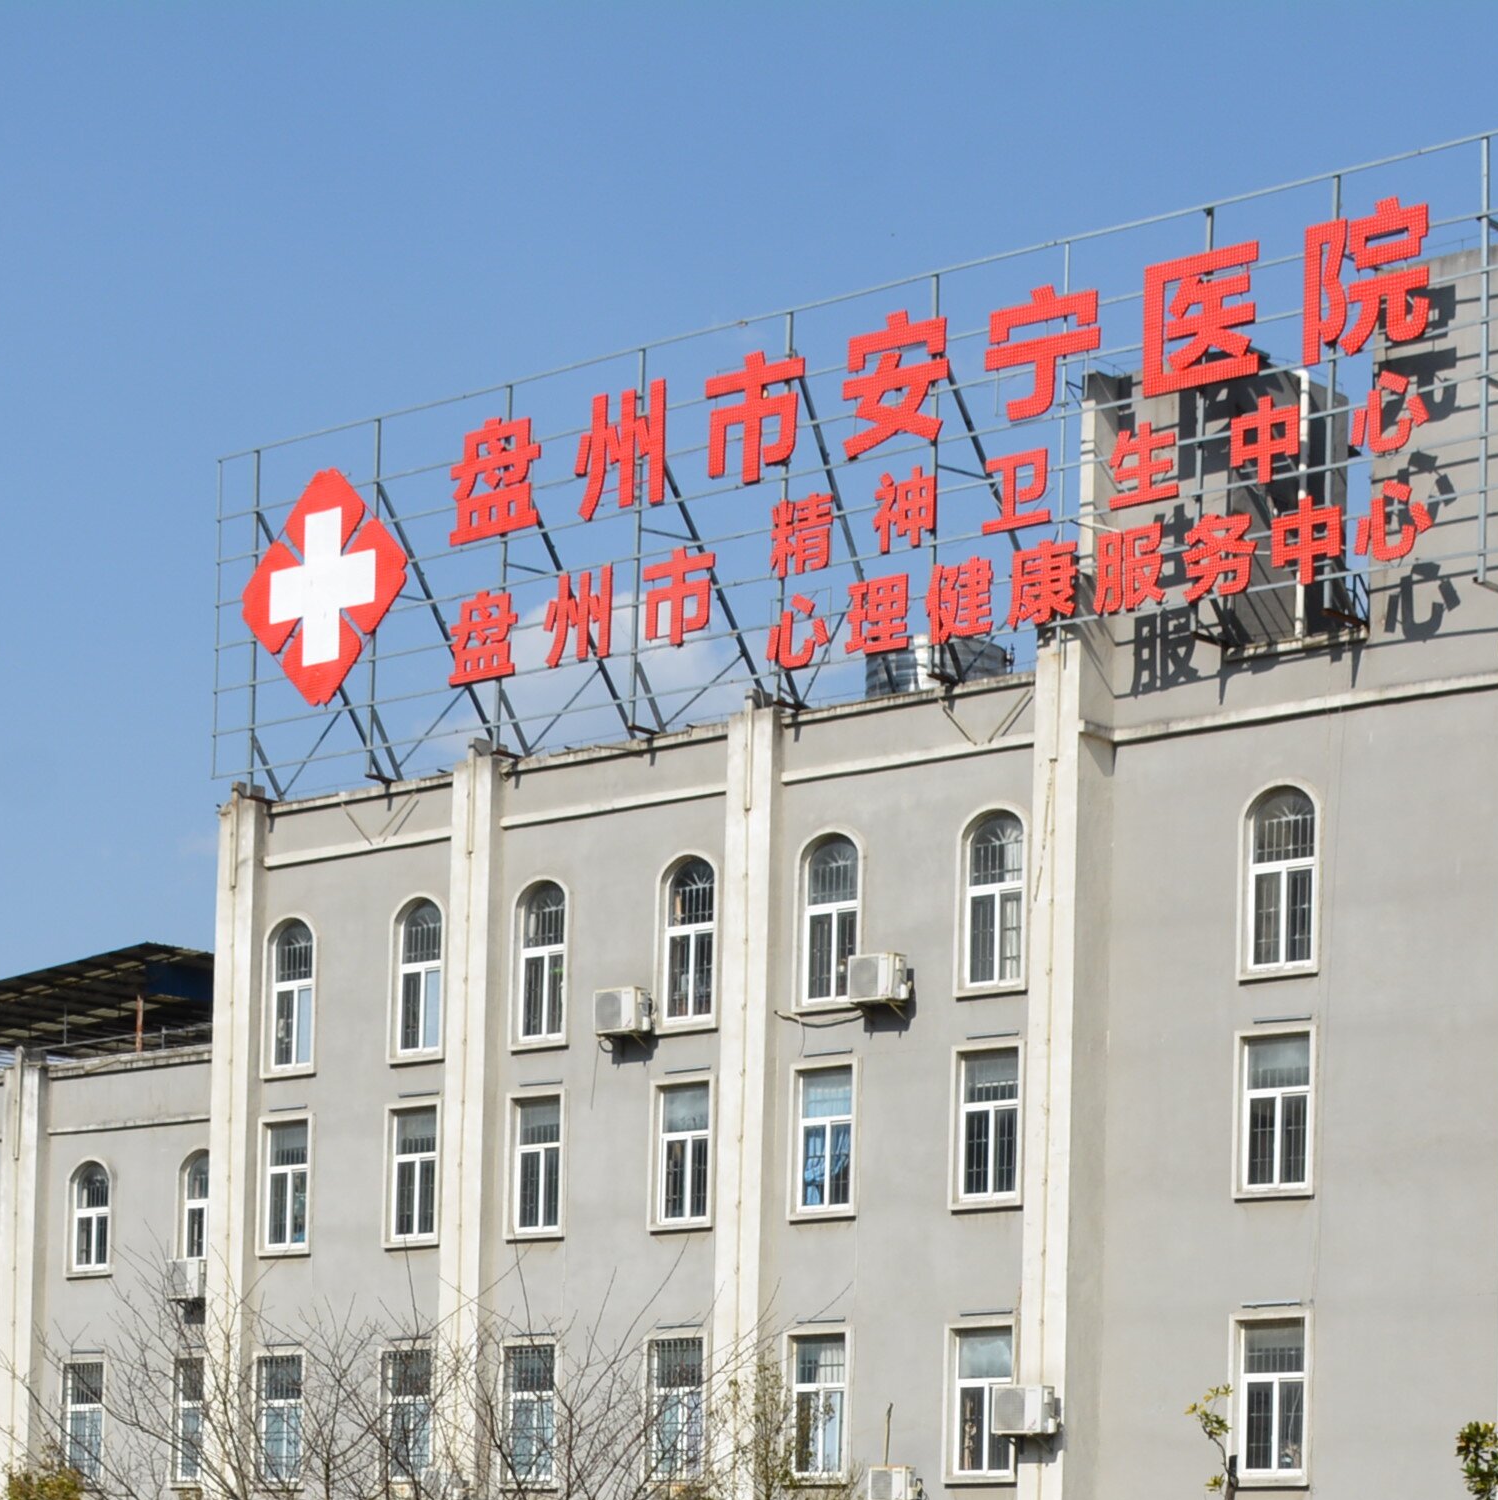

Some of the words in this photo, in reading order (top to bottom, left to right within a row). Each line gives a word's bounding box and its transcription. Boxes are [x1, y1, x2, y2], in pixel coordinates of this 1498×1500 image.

[449, 196, 1432, 546] 盘州市安宁医院
[770, 369, 1430, 578] 精神卫生中心
[448, 547, 716, 686] 盘州市
[765, 496, 1433, 670] 心理健康服务中心
